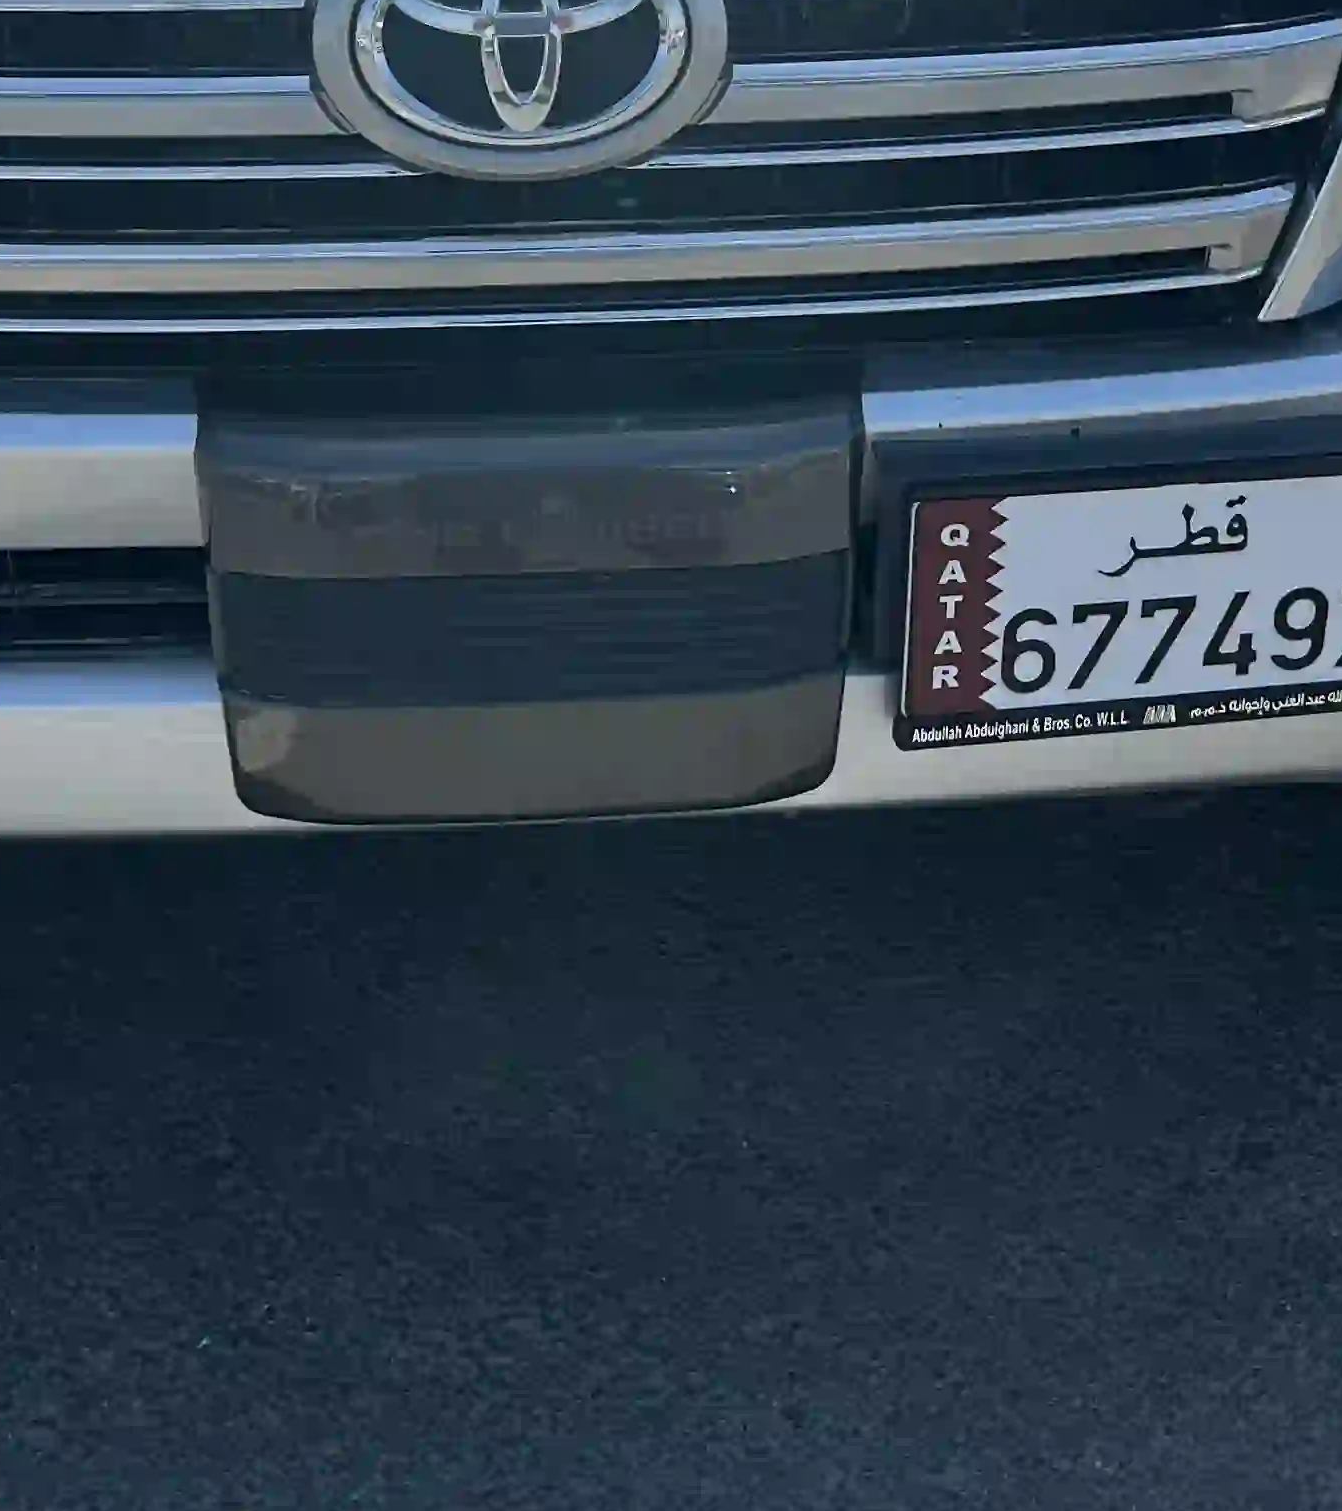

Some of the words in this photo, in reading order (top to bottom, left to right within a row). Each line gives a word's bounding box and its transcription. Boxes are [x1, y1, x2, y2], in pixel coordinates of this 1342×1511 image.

[1098, 495, 1250, 577] قطر
[931, 523, 970, 691] QATAR
[912, 725, 962, 743] Abdullah
[964, 718, 1029, 741] Abdulghani
[1032, 717, 1041, 733] &
